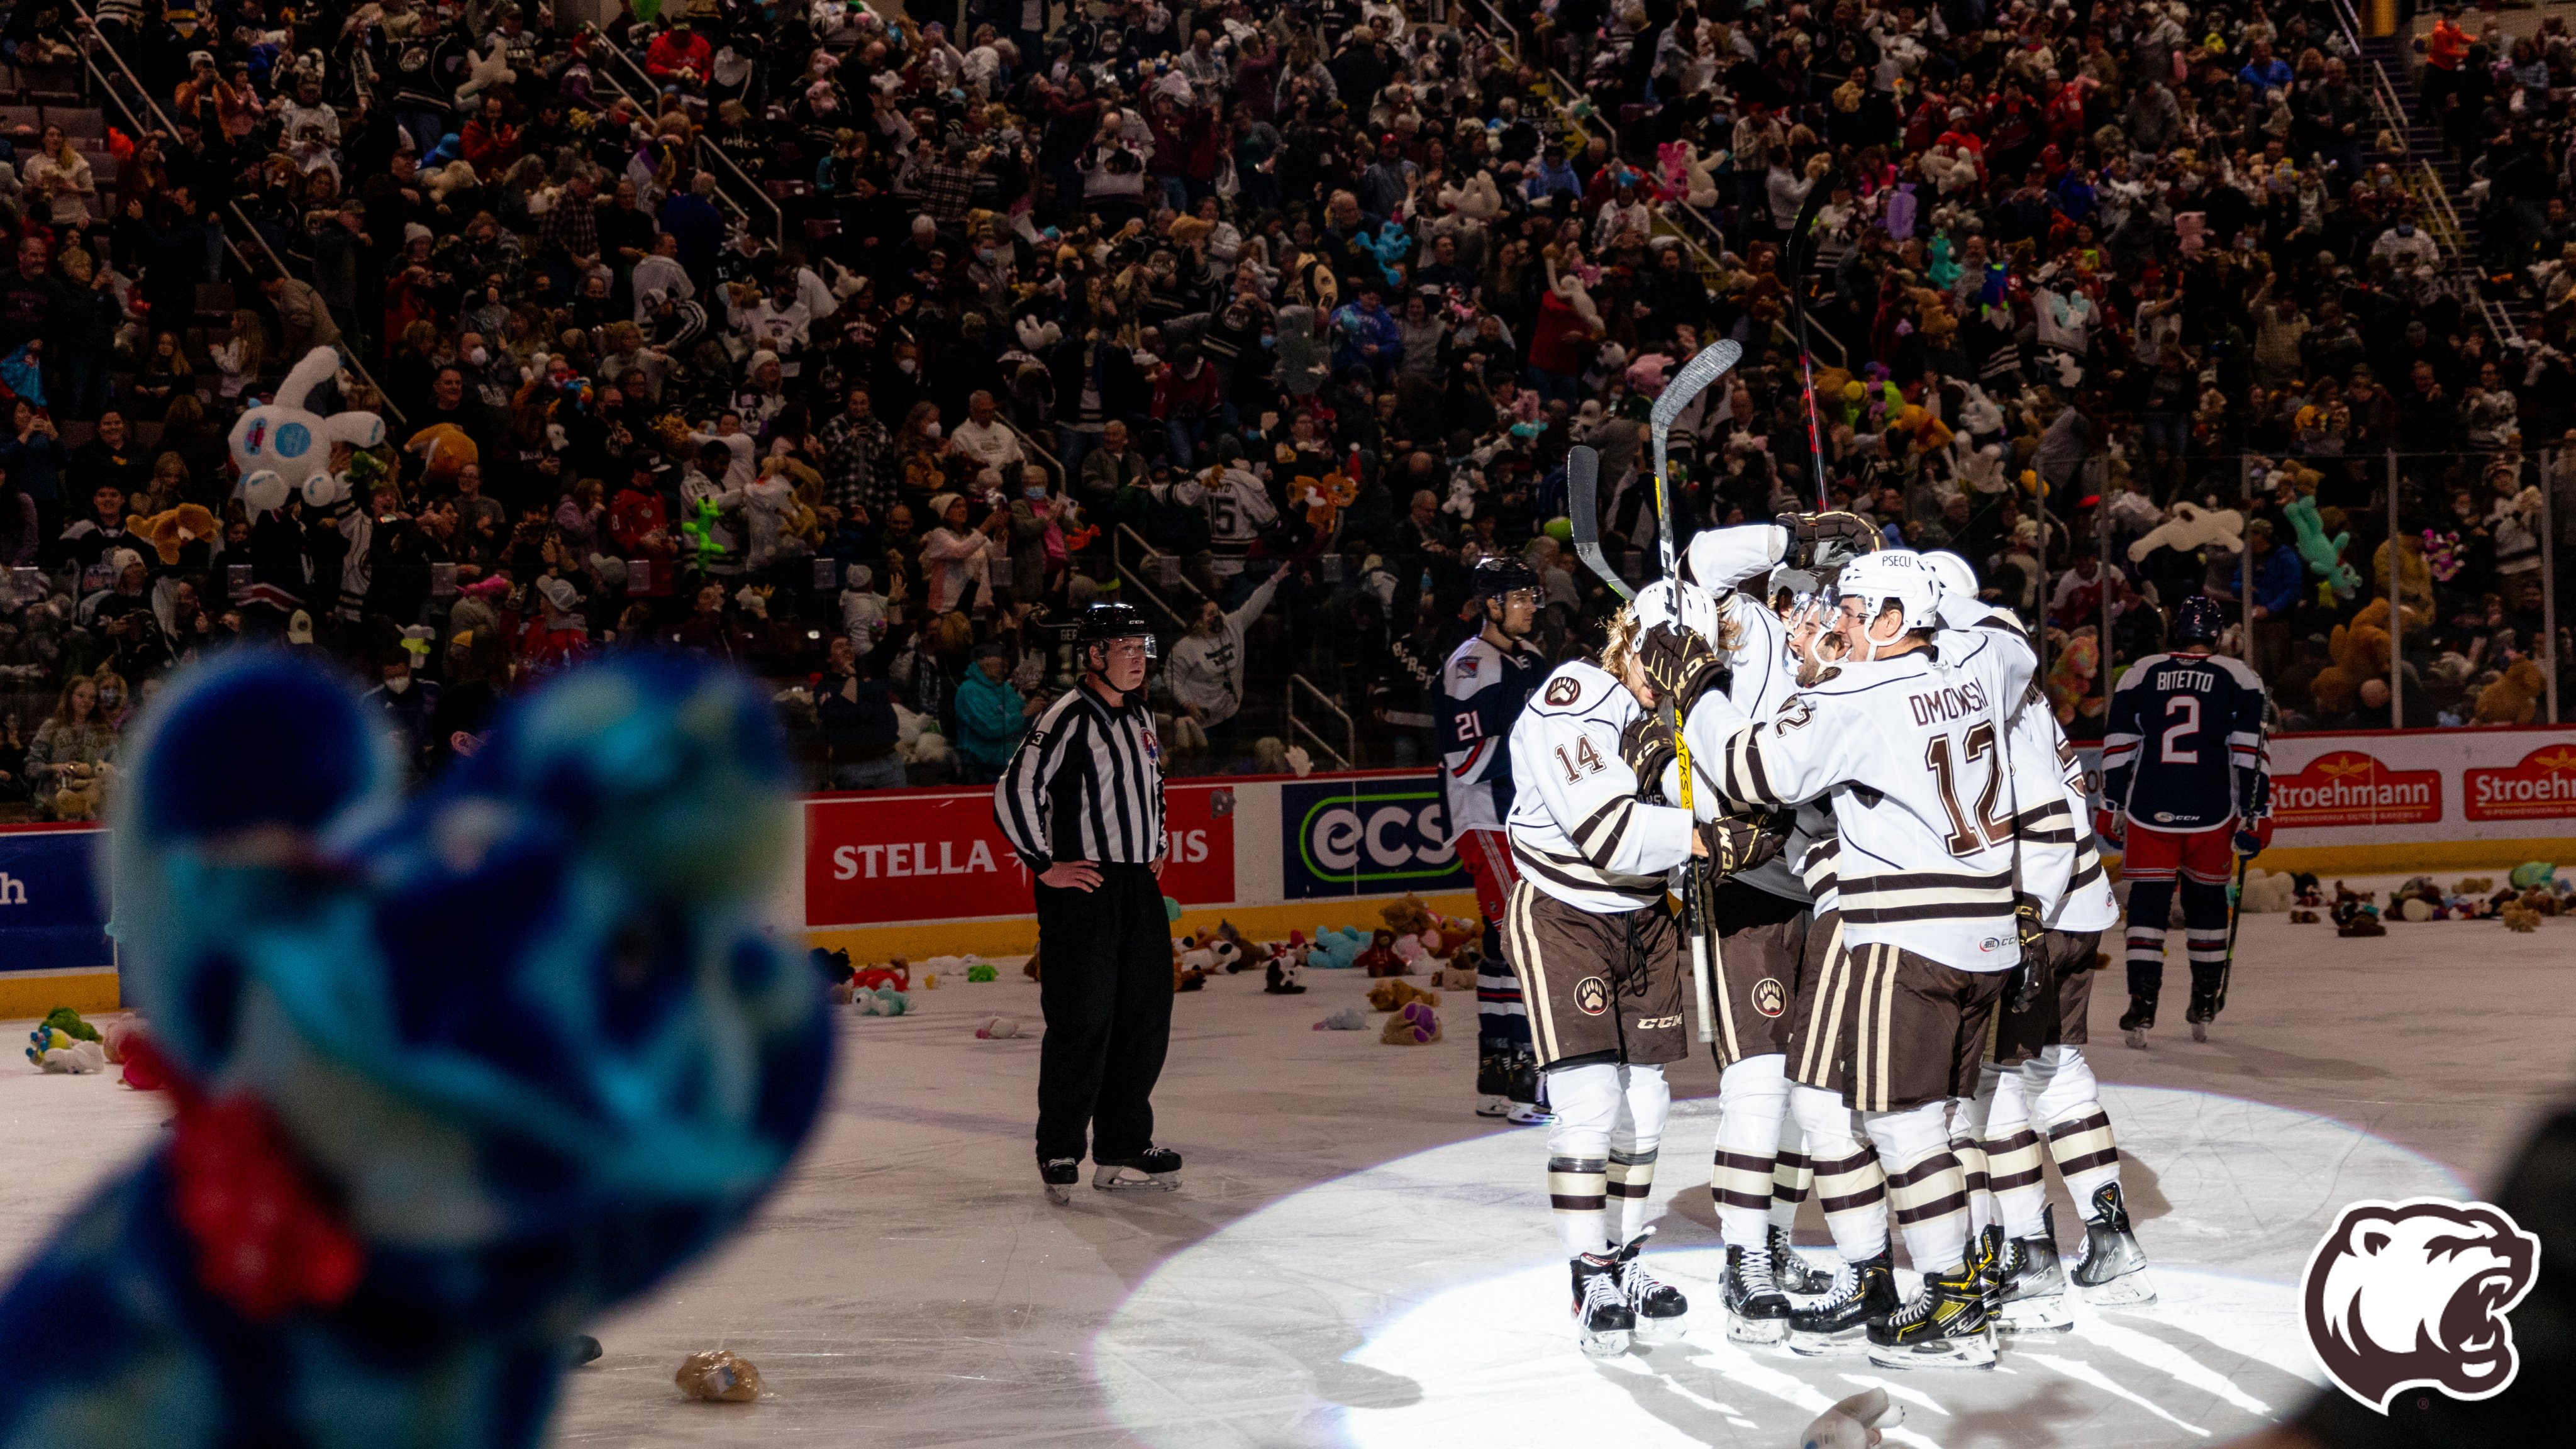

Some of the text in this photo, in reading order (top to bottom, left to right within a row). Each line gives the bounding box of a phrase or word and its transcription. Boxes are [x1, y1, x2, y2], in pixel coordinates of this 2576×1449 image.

[1208, 496, 1236, 536] 15
[1882, 555, 1911, 567] PSECU
[2194, 614, 2201, 625] 2
[2156, 669, 2215, 693] BITETTO
[1031, 732, 1044, 745] 3
[1454, 710, 1483, 741] 21
[2160, 696, 2201, 764] 2
[1555, 735, 1607, 786] 14
[1924, 719, 2014, 858] 12
[2269, 778, 2430, 809] Stroehmann
[2475, 770, 2576, 802] Stroeh
[1313, 803, 1457, 871] ecs
[833, 839, 999, 880] STELLA
[1637, 1013, 1683, 1030] CCM
[1585, 1255, 1609, 1266] CCM
